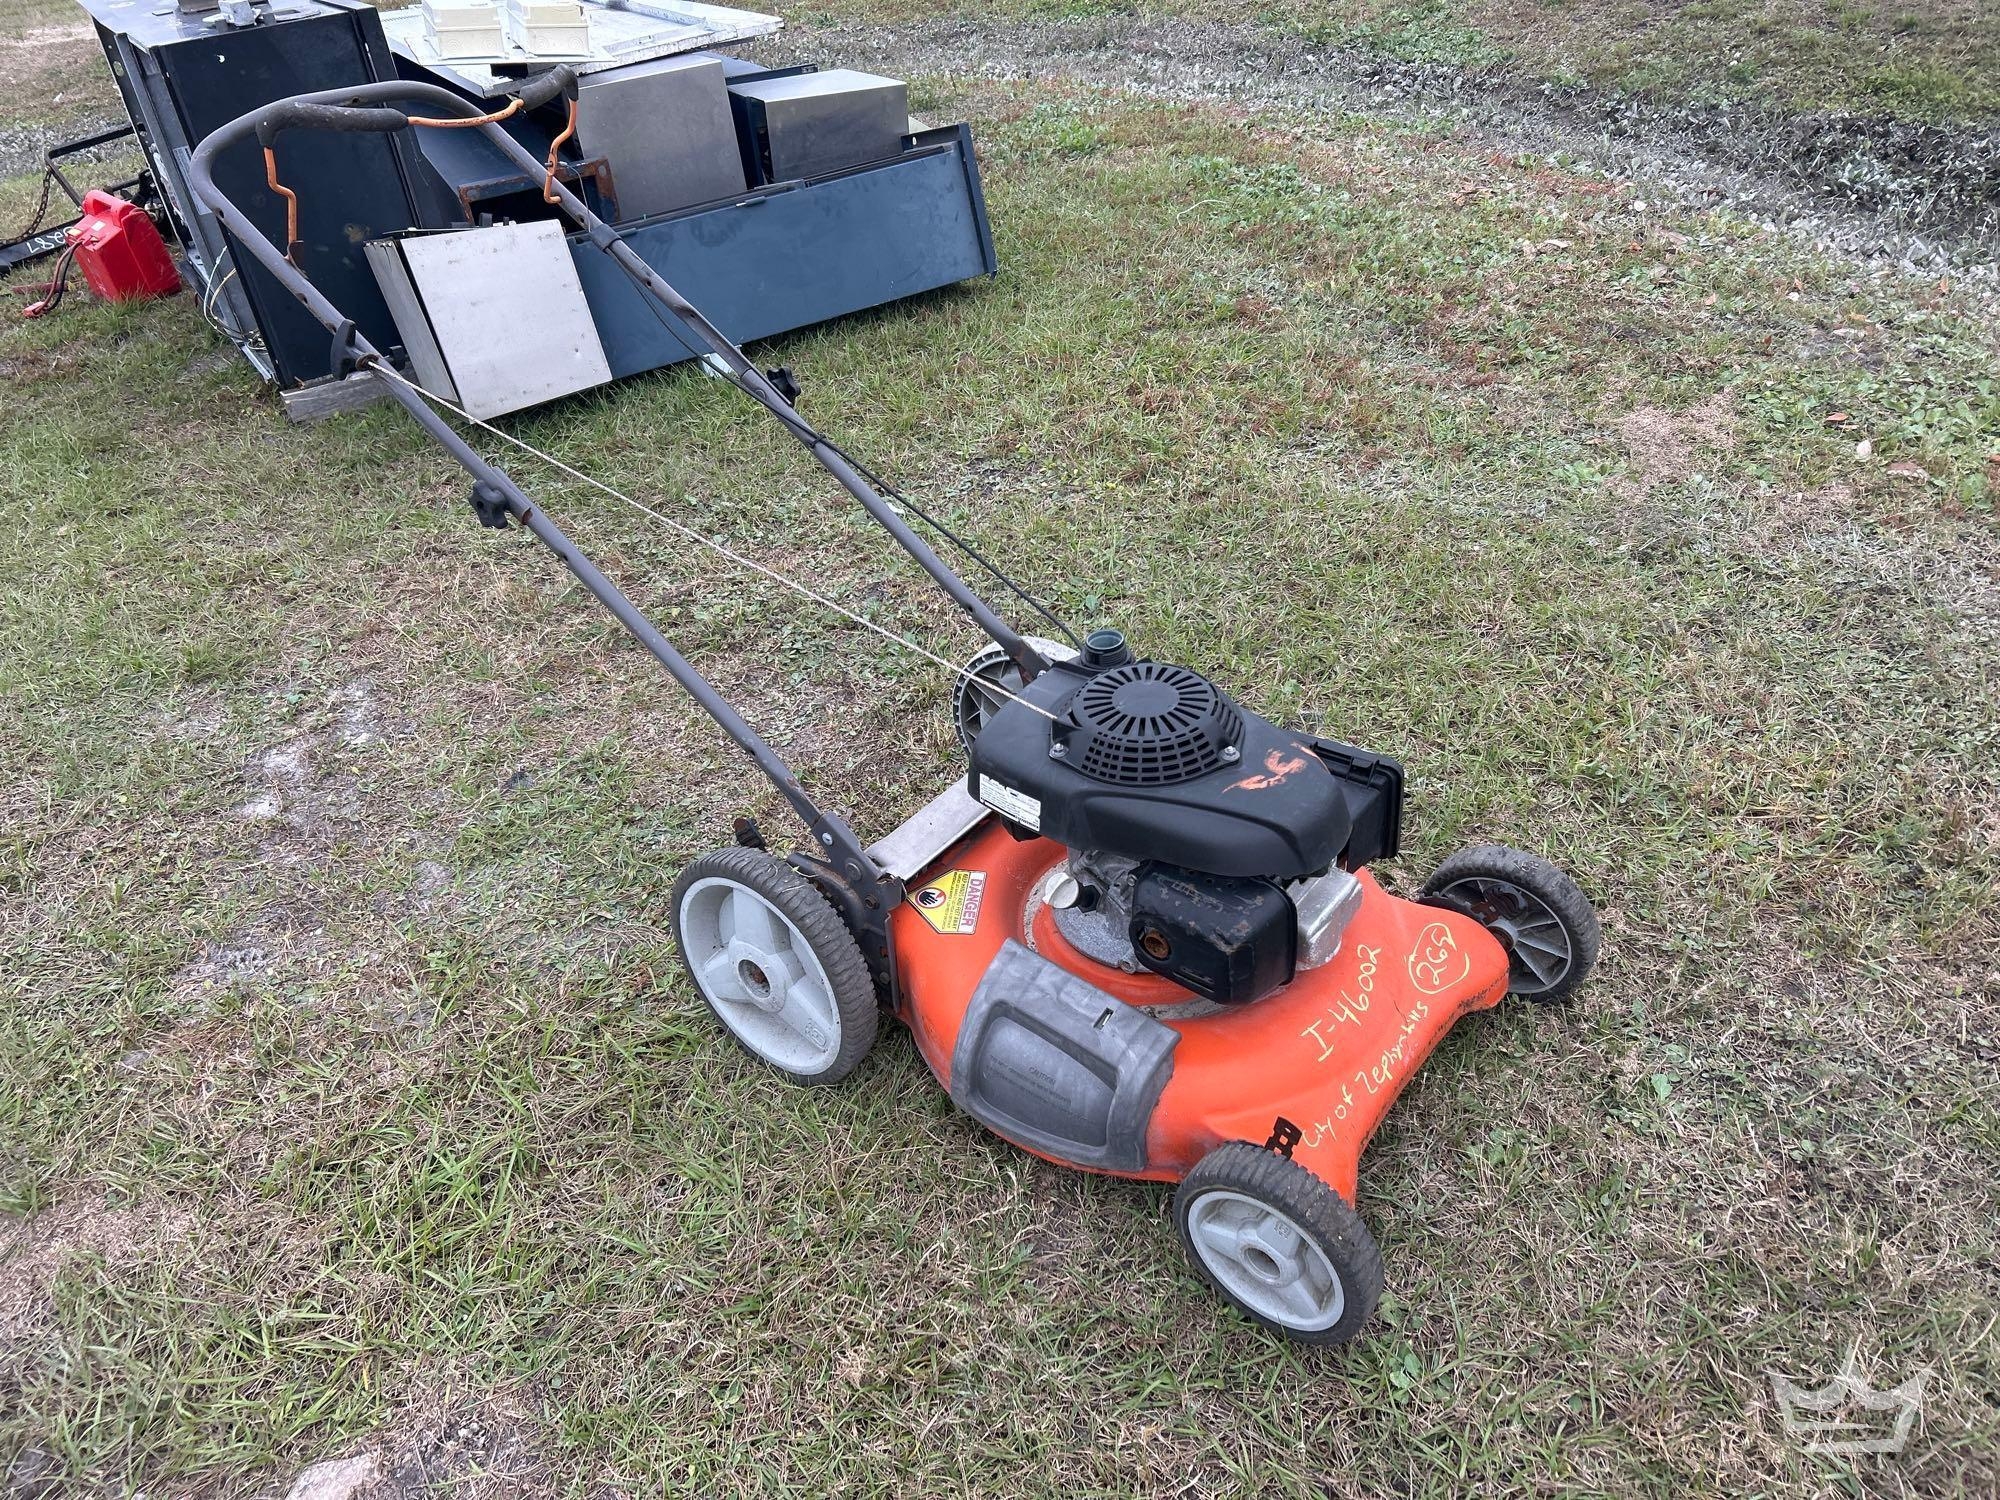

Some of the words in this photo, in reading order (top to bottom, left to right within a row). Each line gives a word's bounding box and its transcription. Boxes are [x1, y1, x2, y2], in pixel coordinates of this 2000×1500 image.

[961, 878, 982, 926] DANGER
[1301, 1116, 1337, 1148] City
[1334, 1083, 1354, 1120] of
